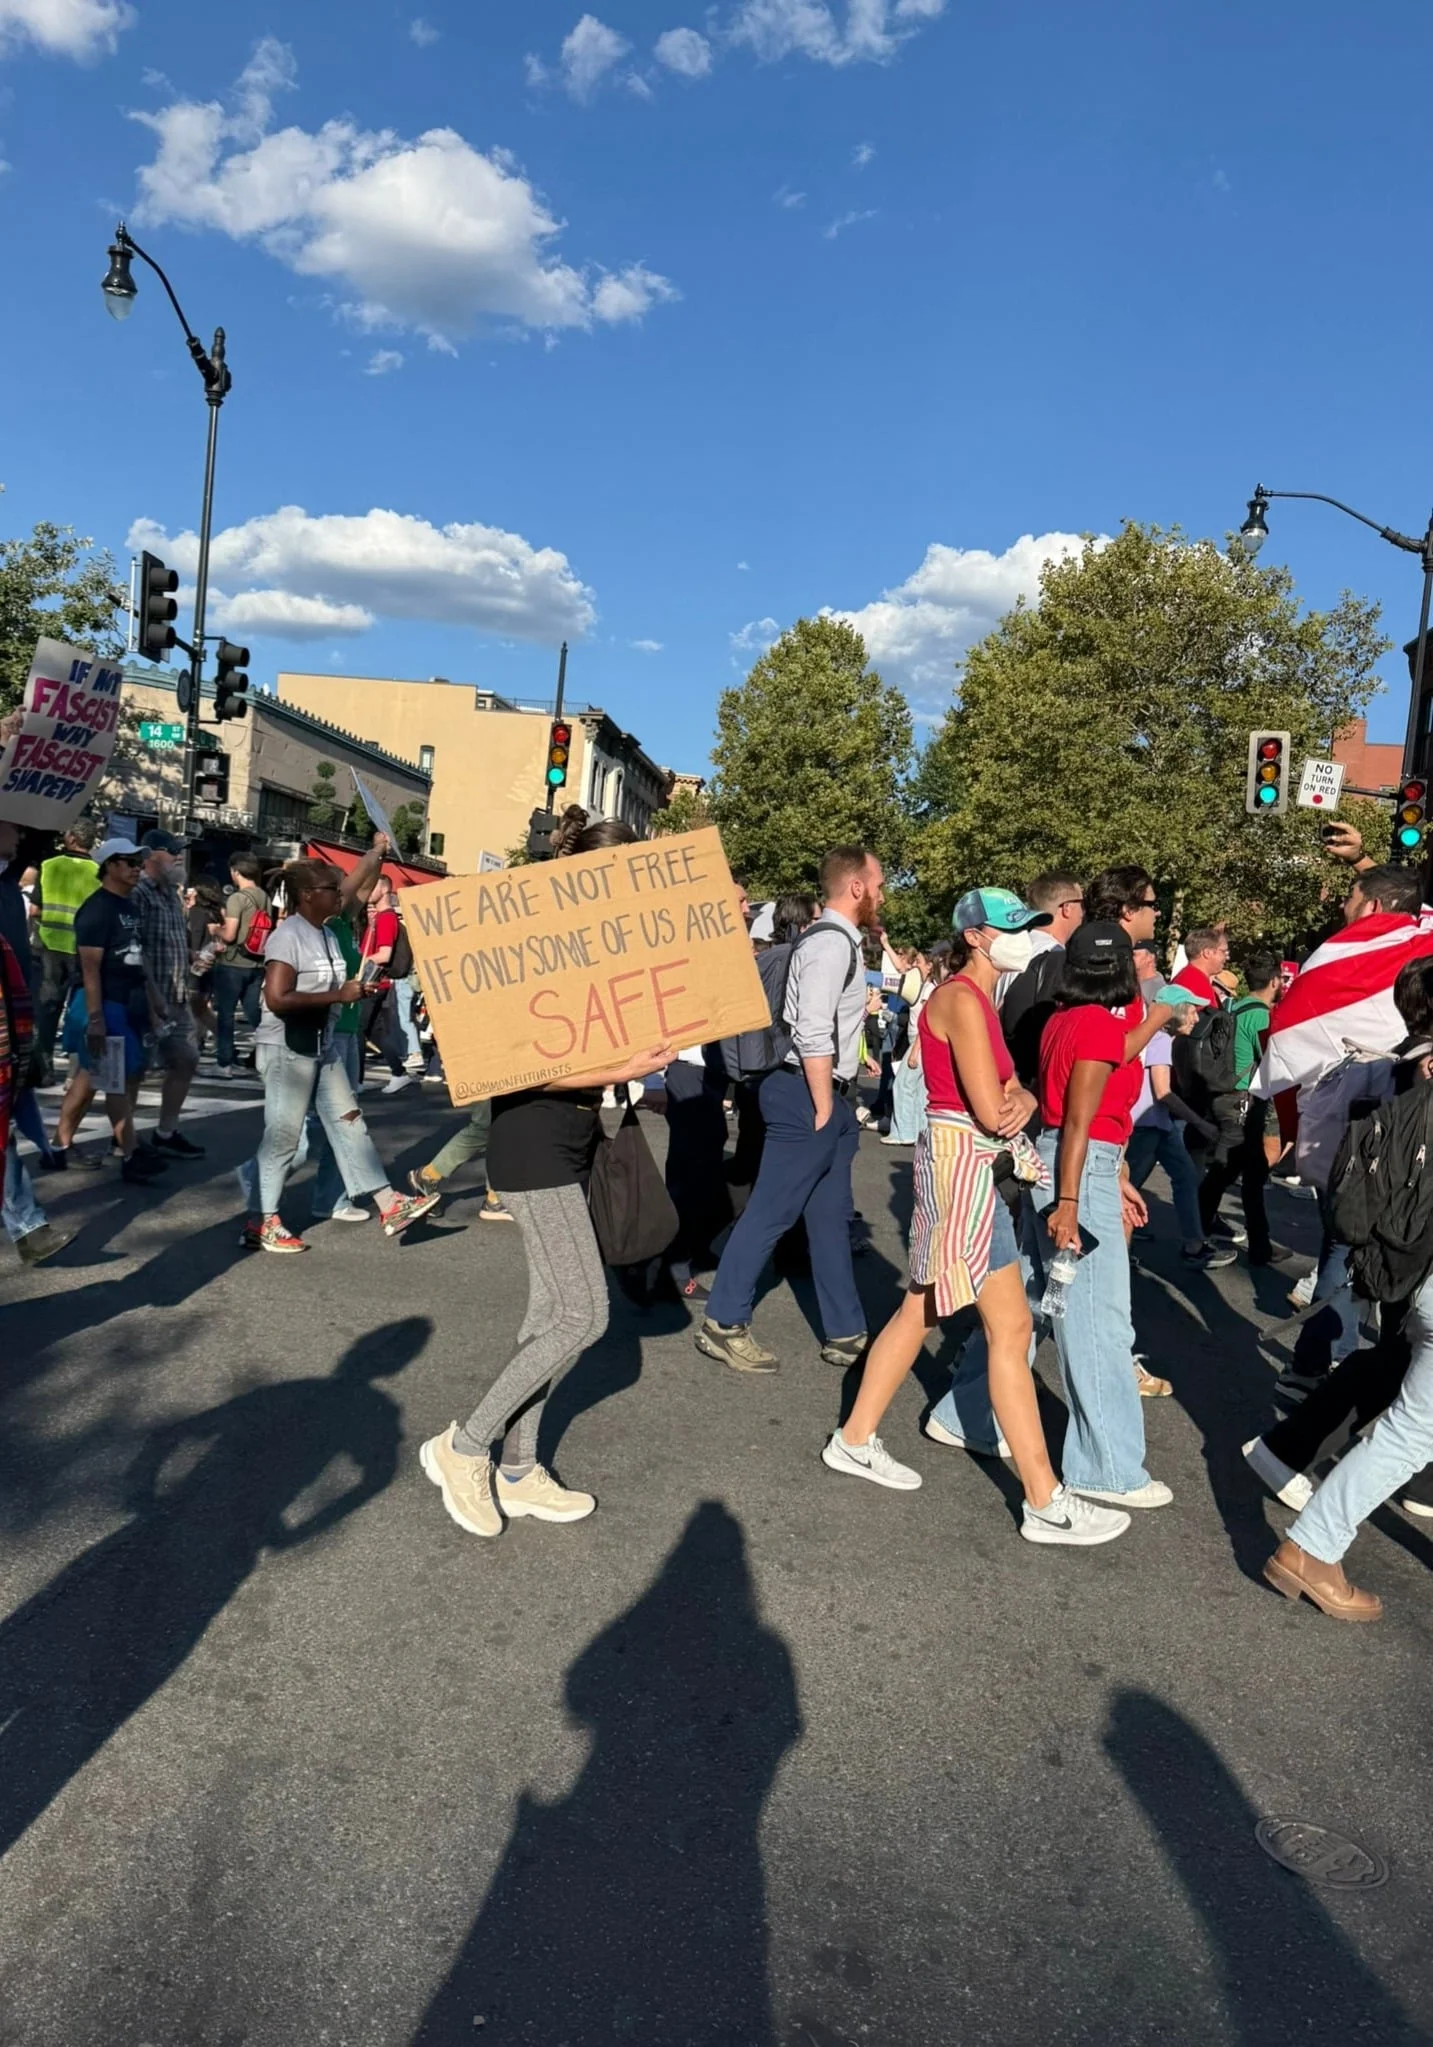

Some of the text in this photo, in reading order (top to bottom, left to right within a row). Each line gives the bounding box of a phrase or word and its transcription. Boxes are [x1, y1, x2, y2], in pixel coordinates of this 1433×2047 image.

[69, 659, 123, 696] IF NOT
[31, 677, 119, 733] FASCIST
[52, 722, 98, 748] WHY
[148, 725, 163, 737] 14
[148, 740, 175, 749] 1600
[10, 735, 107, 782] FASCIST
[1315, 763, 1333, 775] NO
[2, 768, 86, 803] SHAPED?
[1303, 783, 1337, 795] ON RED
[1311, 774, 1334, 785] TURN
[411, 845, 708, 937] WE ARE NOT FREE
[423, 899, 737, 1004] IF ONLY SOME OF US ARE
[528, 958, 709, 1060] SAFE
[455, 1063, 572, 1100] @COMMONFUTURISTS
